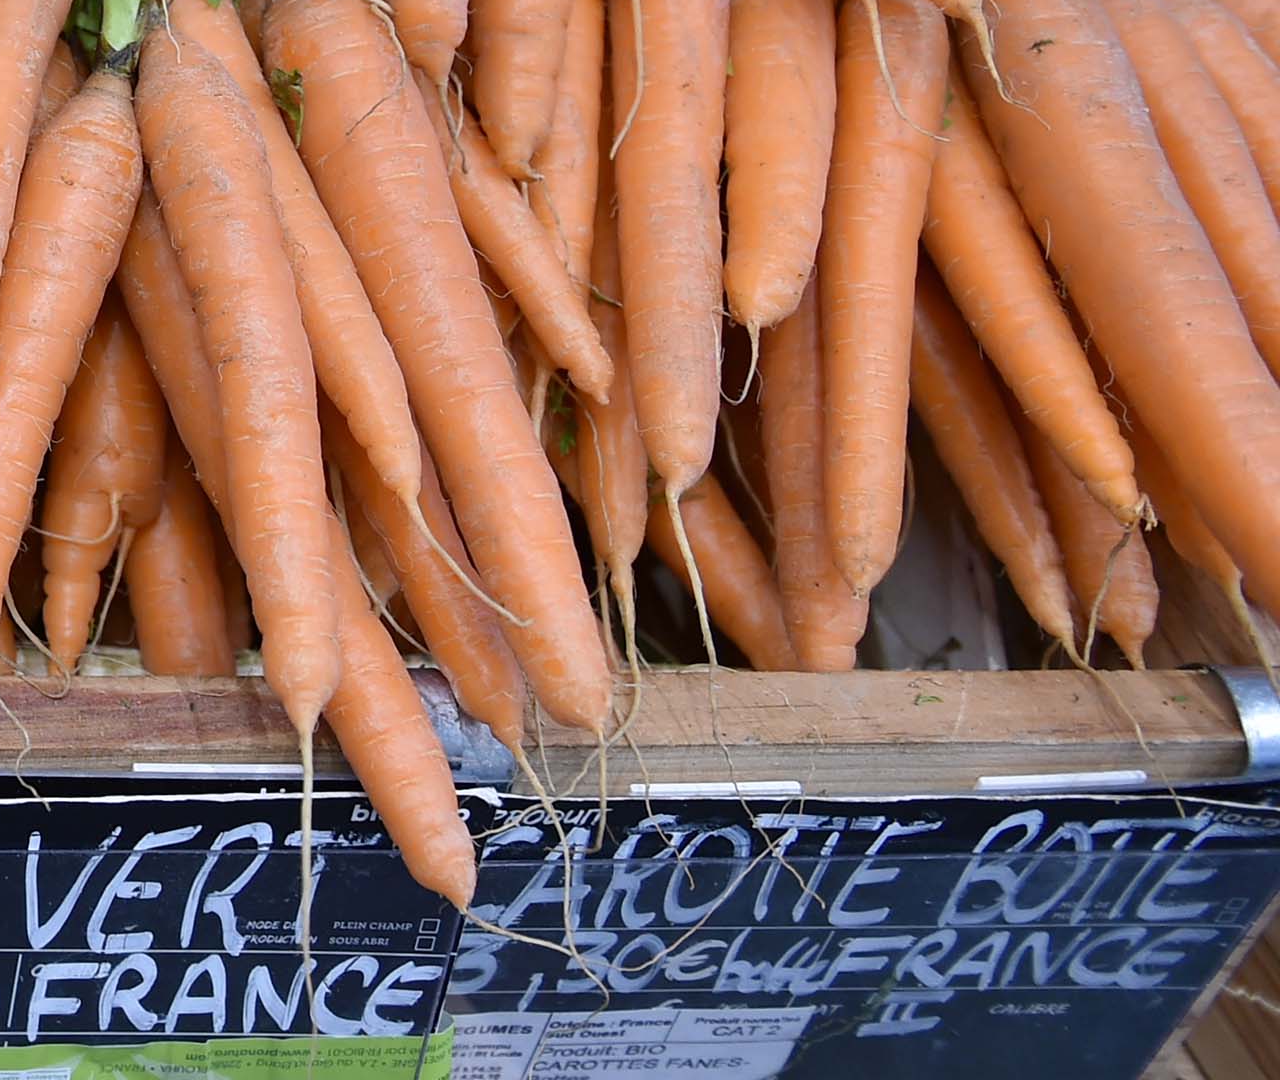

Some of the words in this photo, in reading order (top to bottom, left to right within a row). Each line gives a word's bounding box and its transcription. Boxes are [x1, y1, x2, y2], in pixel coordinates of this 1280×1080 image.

[333, 921, 367, 931] PLEIN
[370, 922, 413, 932] CHAMP
[329, 936, 362, 946] SOUS
[365, 937, 389, 947] ABRI
[826, 924, 1219, 992] FRANCE
[26, 952, 442, 1043] FRANCE
[712, 1025, 764, 1038] CAT
[766, 1026, 782, 1037] 2
[625, 1044, 668, 1056] BIO
[532, 1058, 658, 1072] CAROTTES
